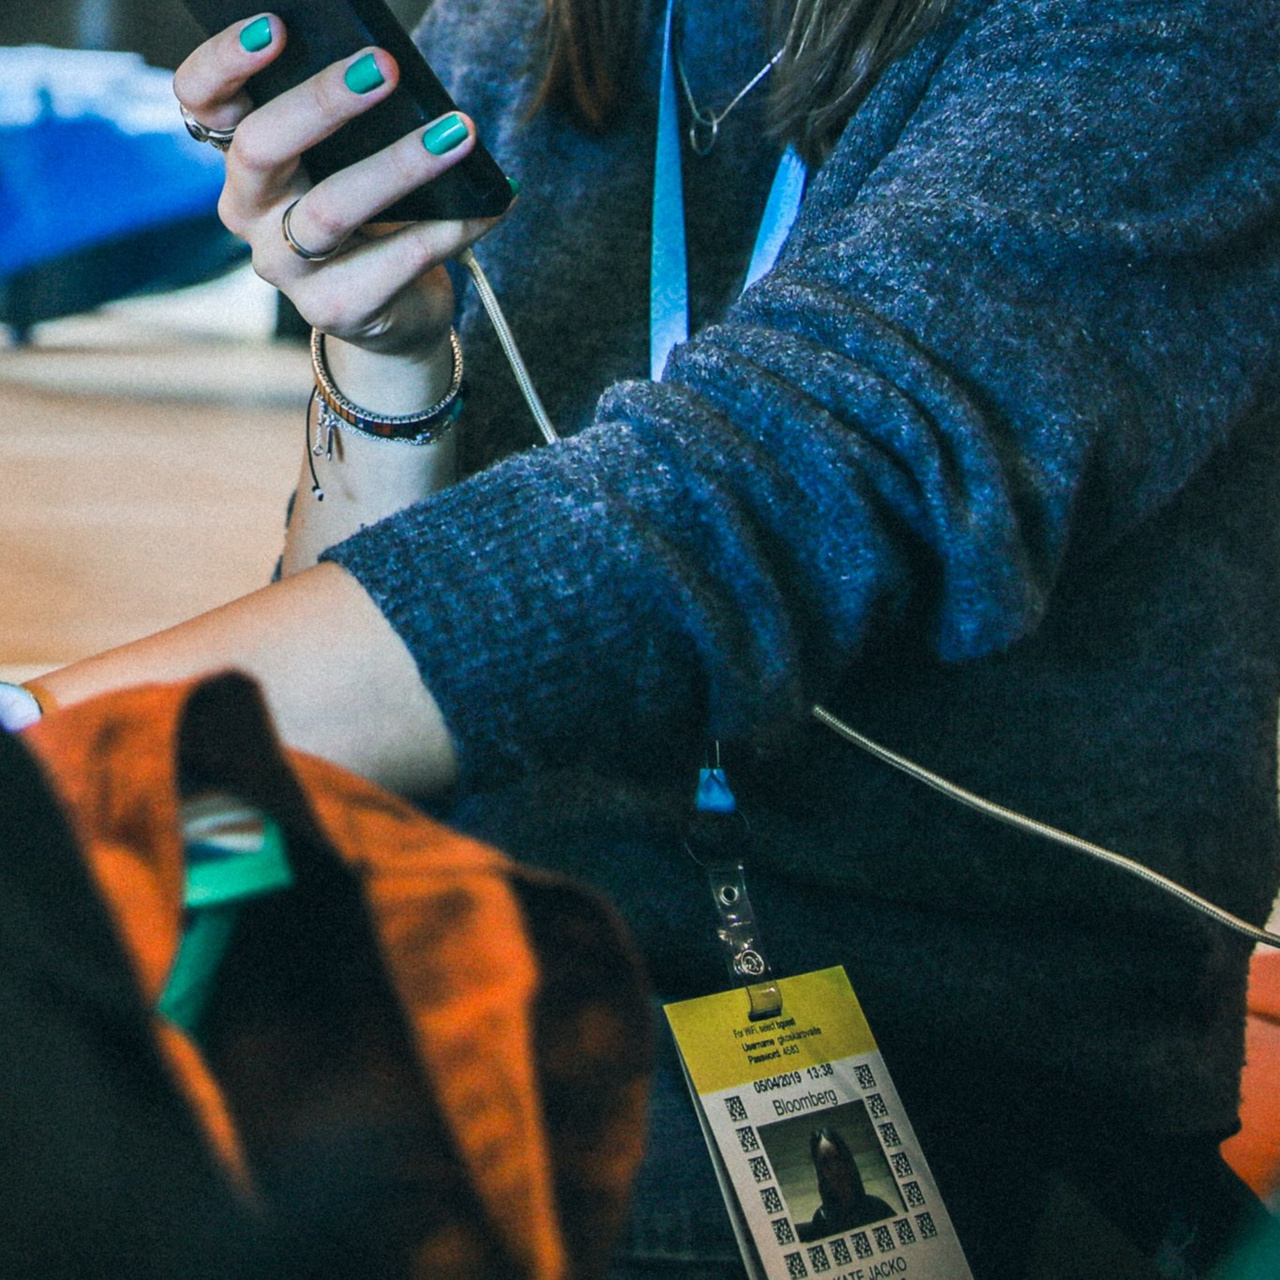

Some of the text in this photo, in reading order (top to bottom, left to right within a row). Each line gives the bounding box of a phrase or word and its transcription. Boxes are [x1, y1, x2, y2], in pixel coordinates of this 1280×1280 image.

[741, 1039, 775, 1052] Username
[753, 1063, 834, 1094] 05/04/2019 13:38
[772, 1089, 839, 1116] Bloomberg
[868, 1256, 907, 1280] JACKO
